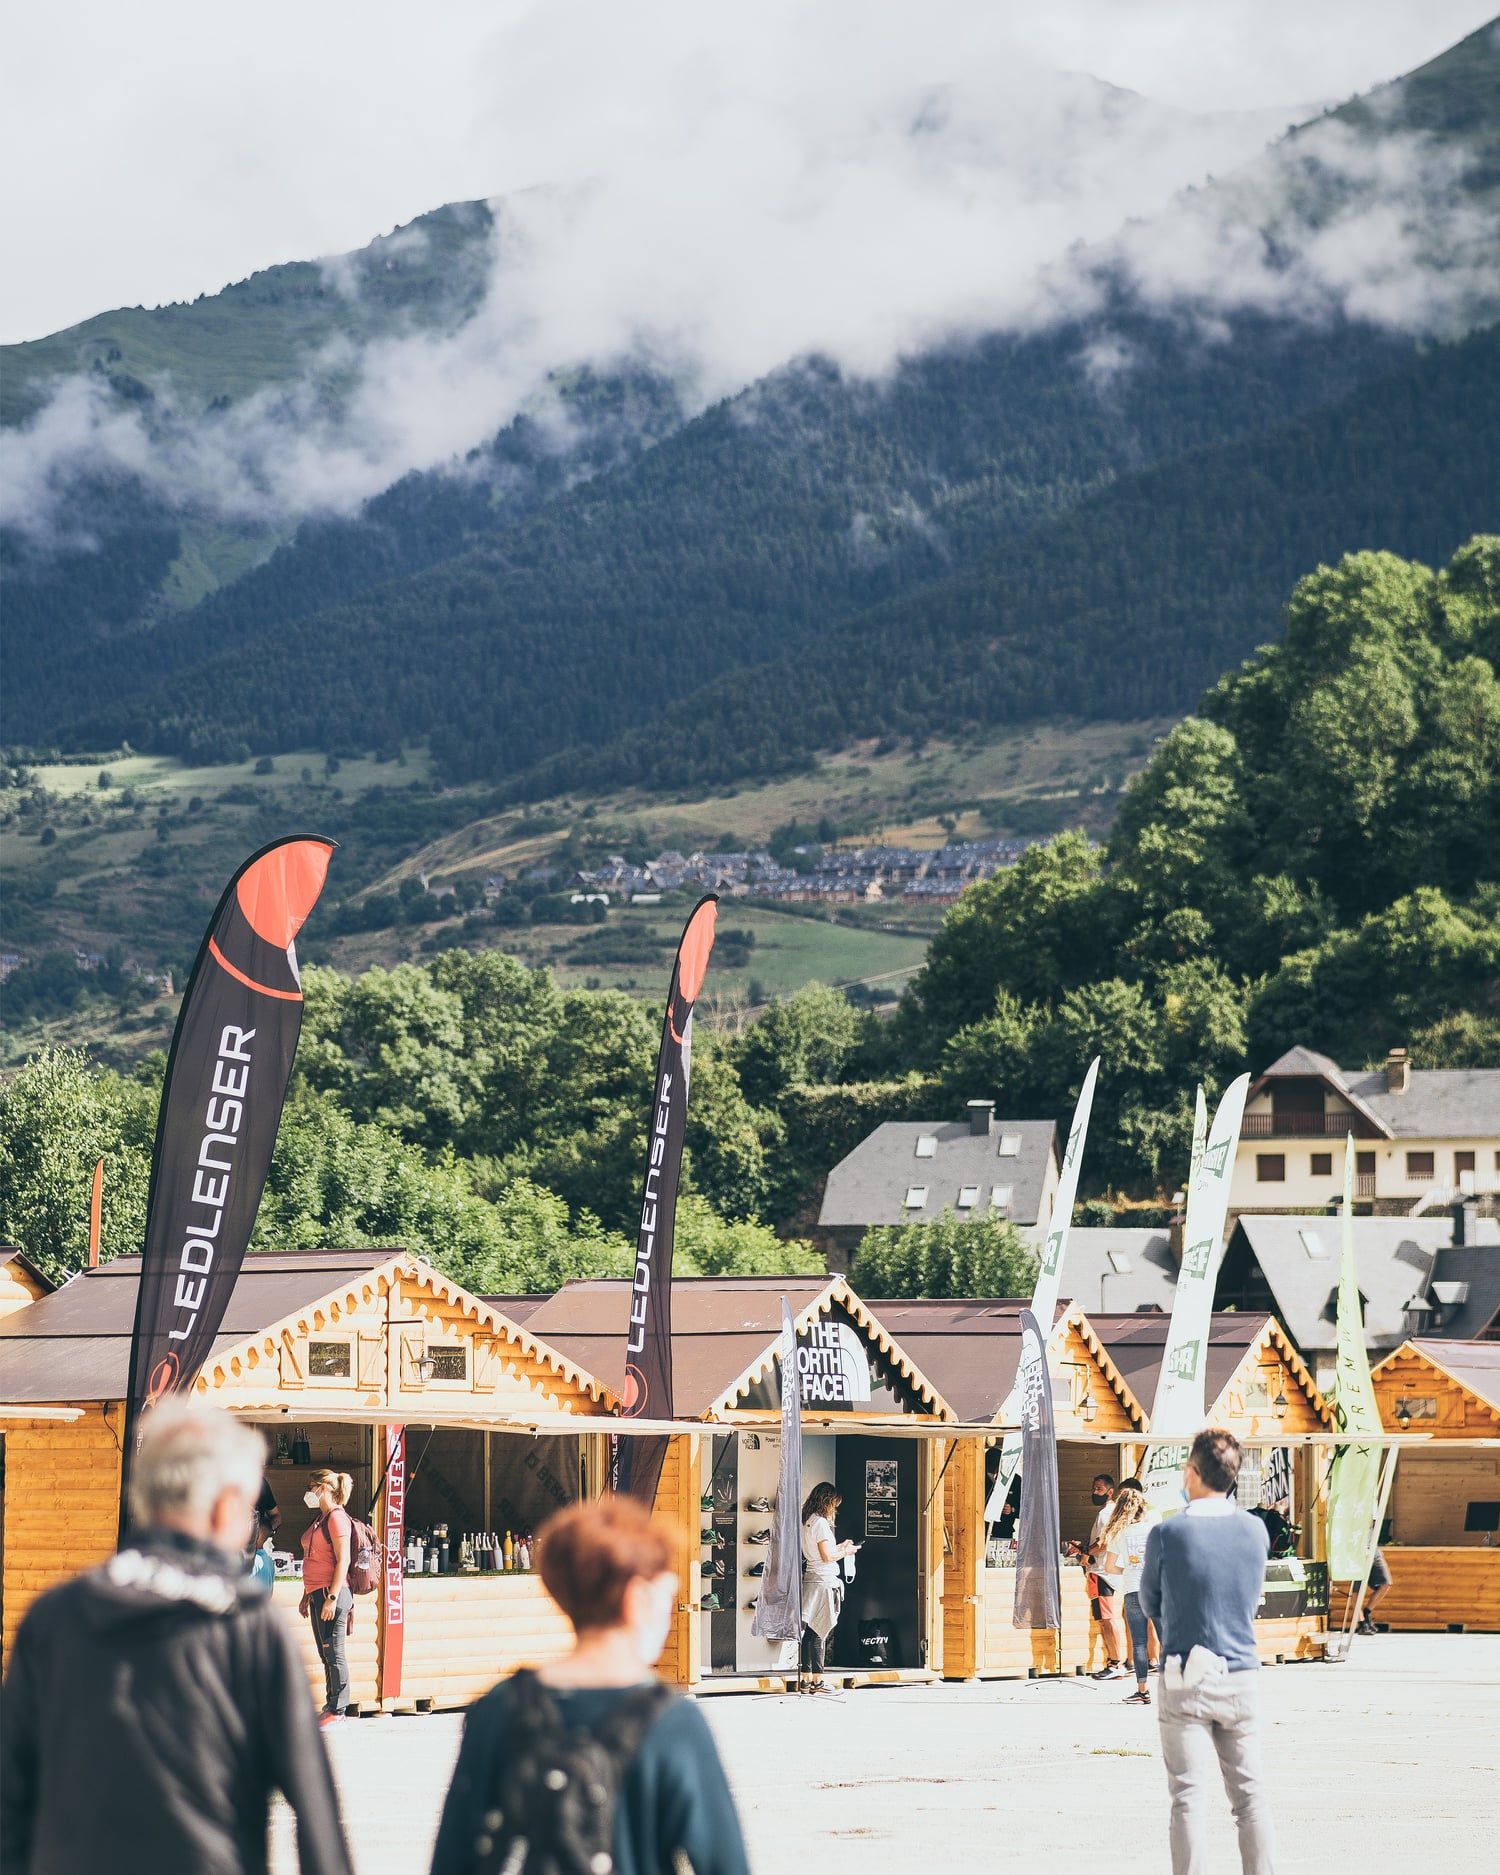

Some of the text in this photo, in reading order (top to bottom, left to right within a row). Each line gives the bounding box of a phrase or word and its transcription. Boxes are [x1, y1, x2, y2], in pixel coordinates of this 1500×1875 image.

[168, 1024, 257, 1341] LEDLENSER
[627, 1072, 673, 1353] LEDLENSER
[797, 1346, 841, 1374] ORTH
[808, 1321, 840, 1348] THE
[803, 1373, 844, 1402] FACE
[611, 1433, 619, 1491] STANLE
[387, 1550, 403, 1625] DARK
